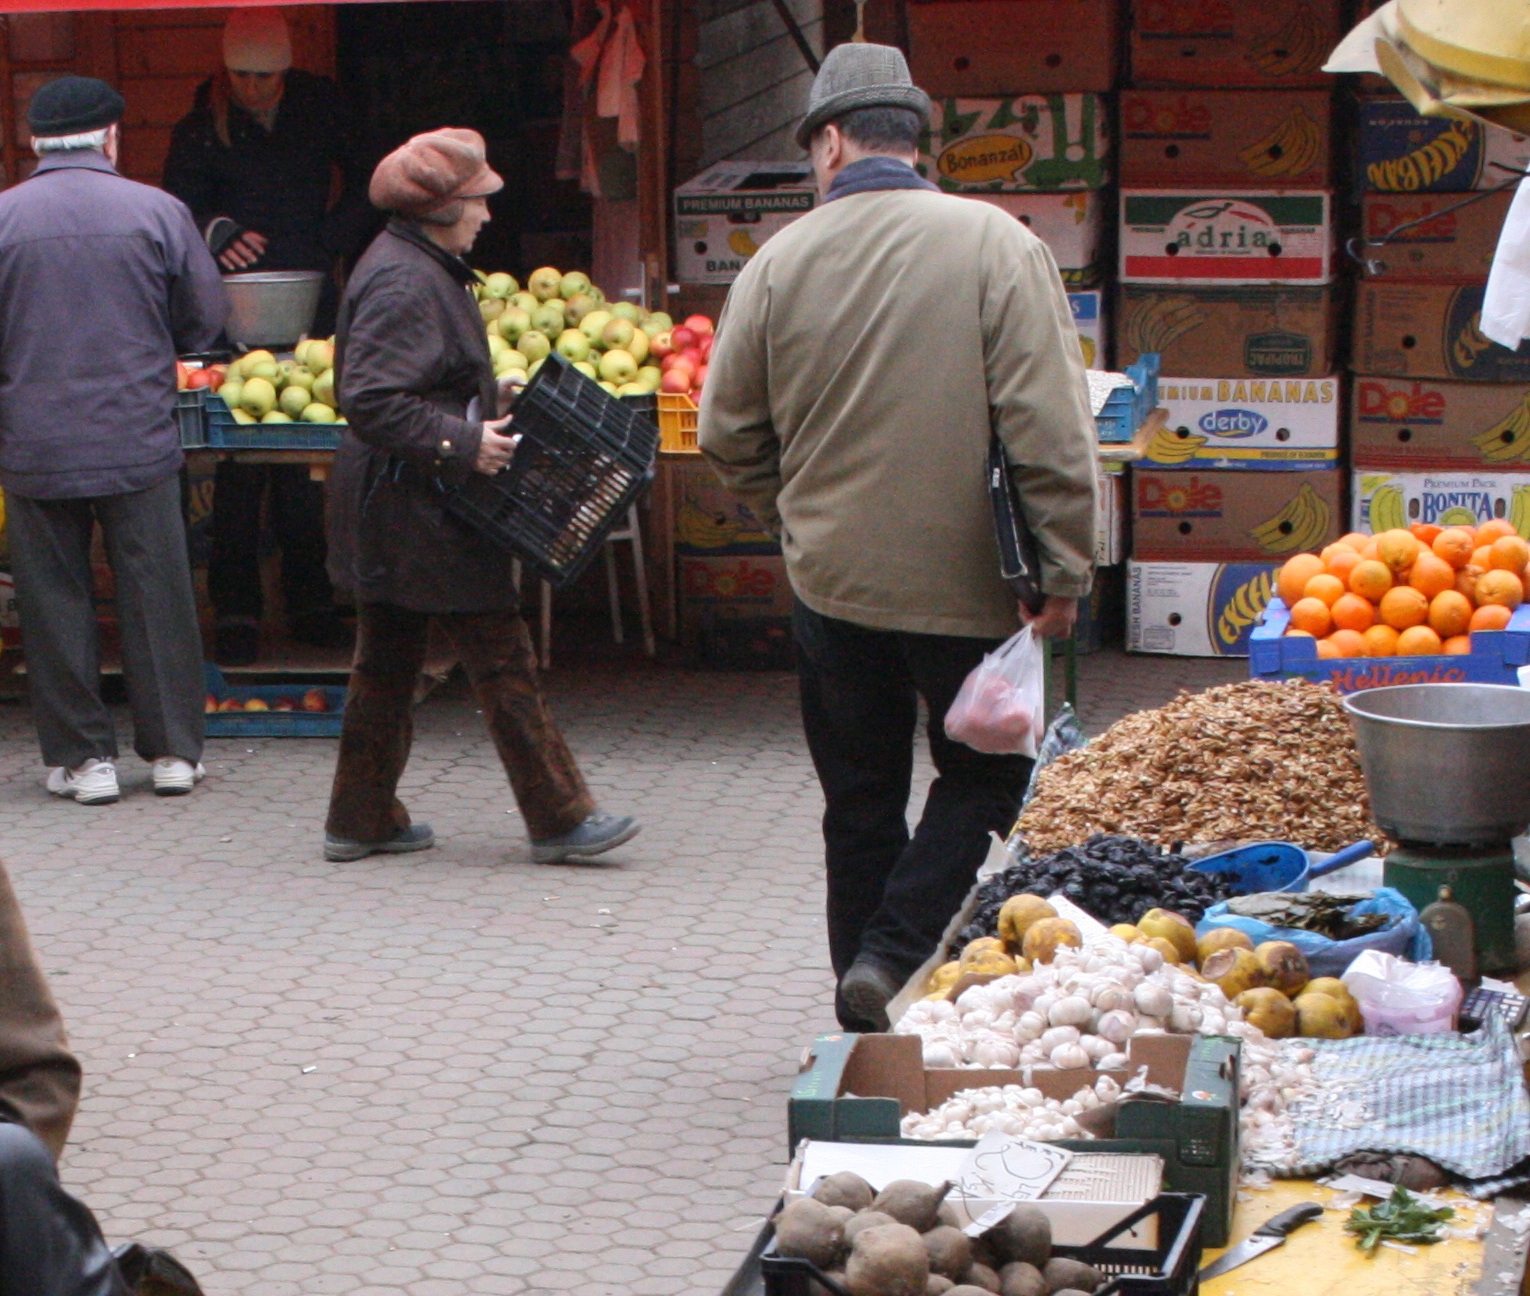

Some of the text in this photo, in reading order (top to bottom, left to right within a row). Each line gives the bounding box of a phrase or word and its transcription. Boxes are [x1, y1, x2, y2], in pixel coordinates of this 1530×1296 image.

[683, 196, 810, 211] PREMIUM BANANAS
[1176, 225, 1269, 248] adria
[1217, 381, 1334, 404] BANANAS
[1358, 383, 1446, 419] Dole
[1203, 411, 1264, 435] derby
[1138, 476, 1223, 511] Dole
[1422, 492, 1493, 525] BONITA
[1329, 664, 1467, 692] Hellenic
